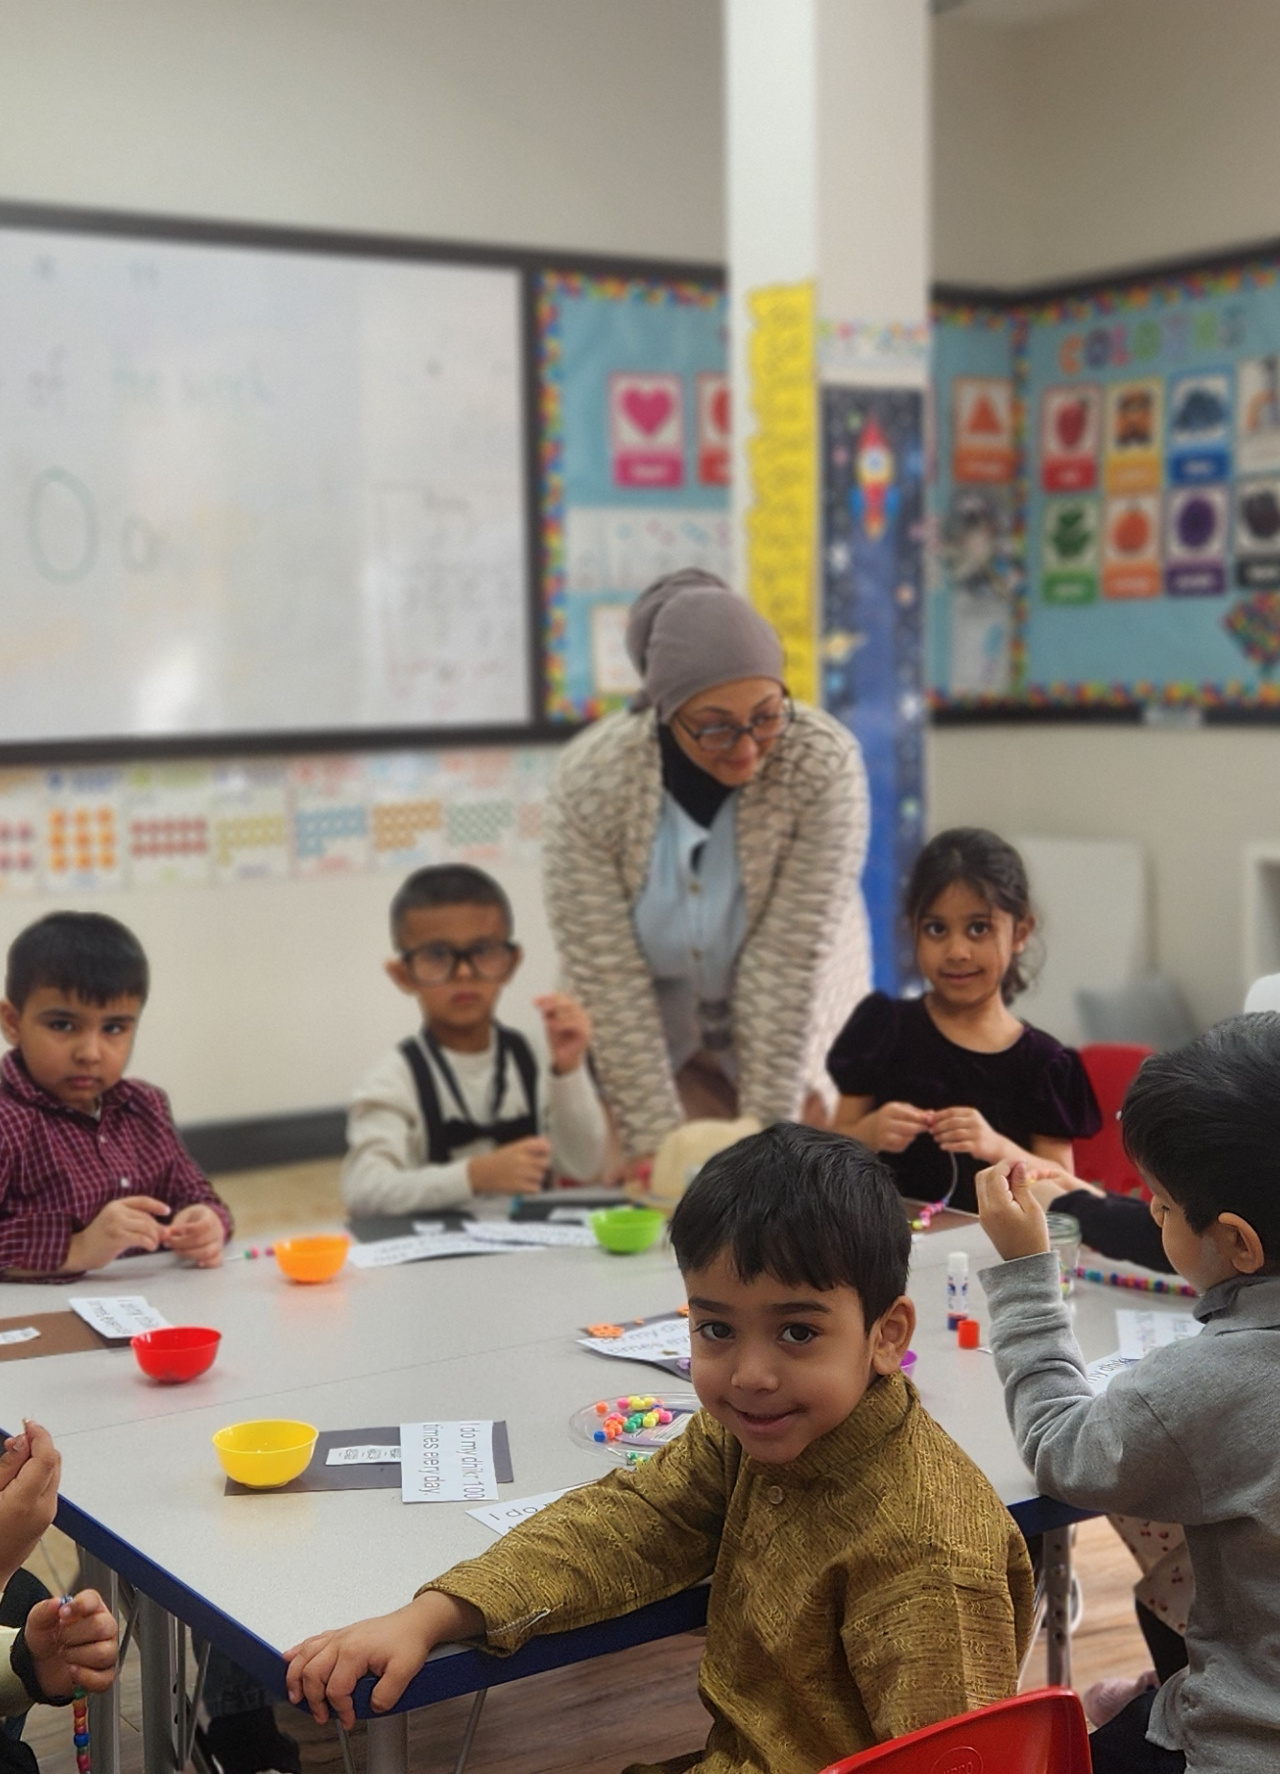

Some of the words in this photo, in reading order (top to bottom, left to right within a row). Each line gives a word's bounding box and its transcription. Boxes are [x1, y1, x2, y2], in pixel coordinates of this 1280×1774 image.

[423, 1424, 443, 1449] times
[460, 1428, 480, 1439] do
[456, 1441, 477, 1456] my
[463, 1481, 486, 1499] 100
